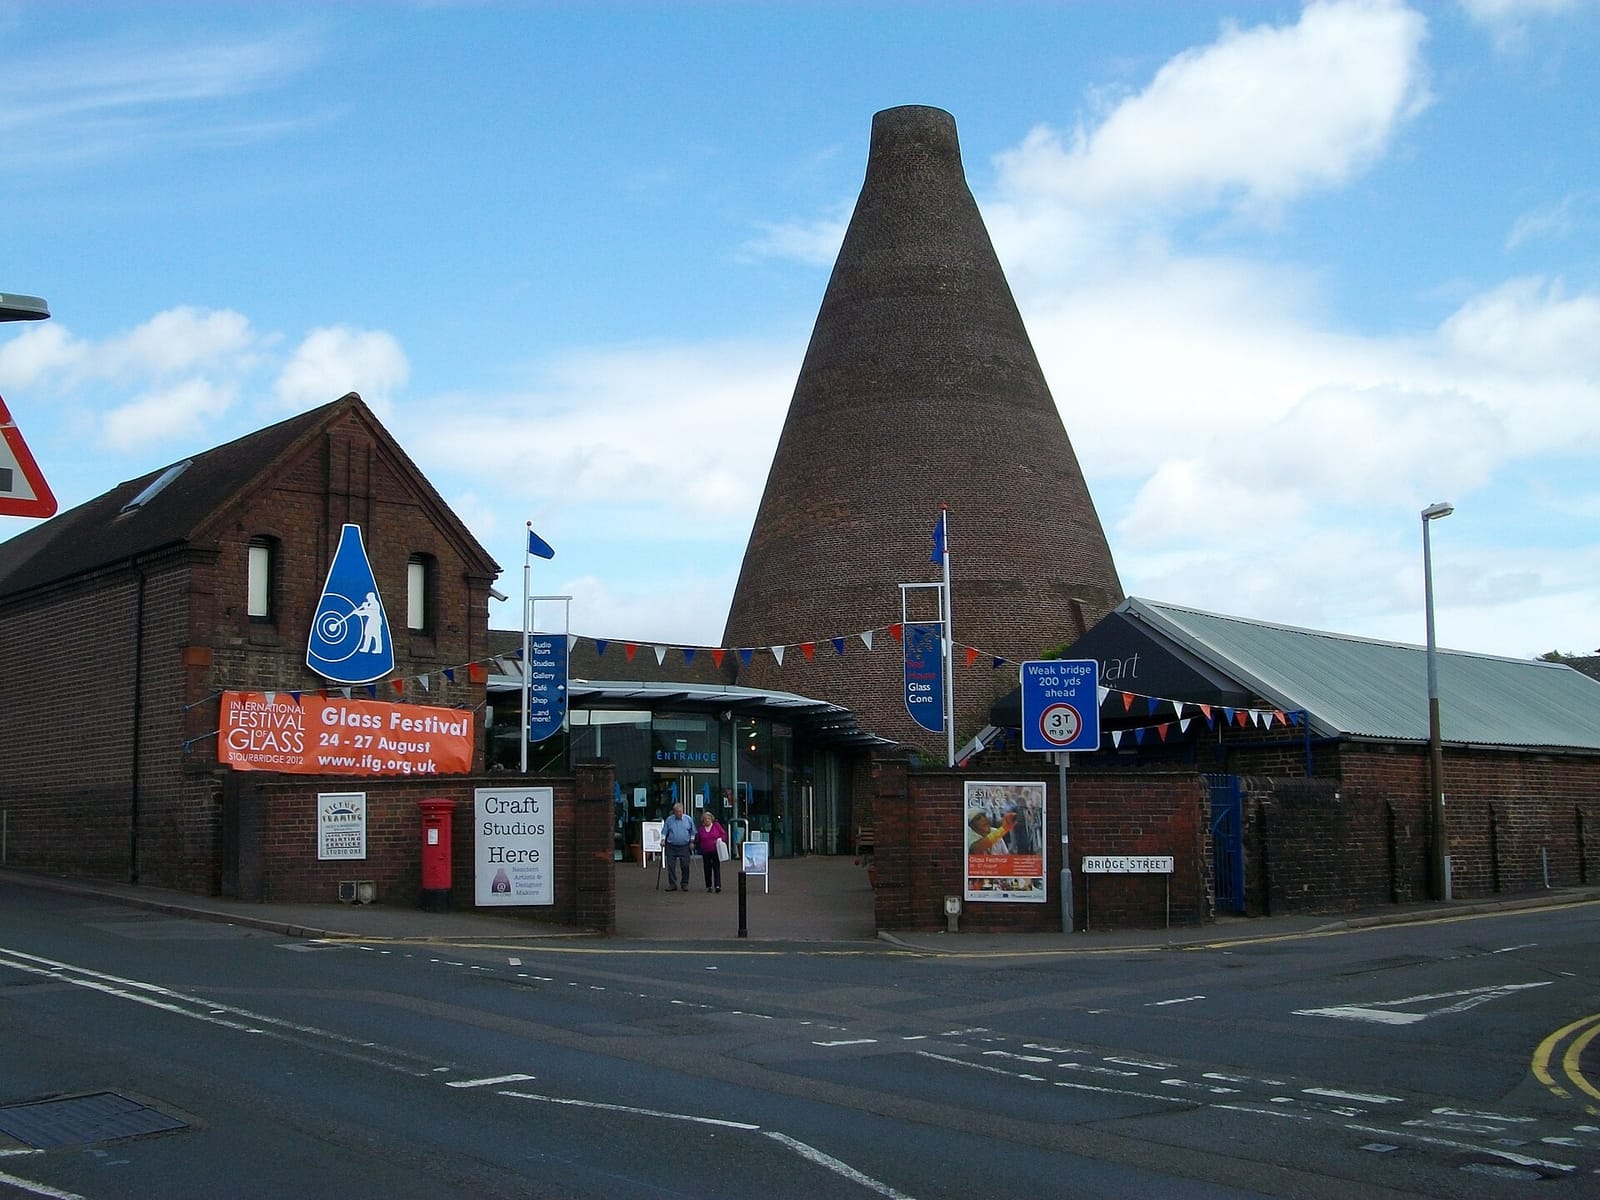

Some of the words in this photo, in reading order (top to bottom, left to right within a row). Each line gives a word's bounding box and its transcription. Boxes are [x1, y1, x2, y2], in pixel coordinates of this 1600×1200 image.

[532, 672, 555, 680] Gallery
[1028, 666, 1056, 675] Weak
[1060, 665, 1091, 676] bridge
[908, 682, 931, 692] Glass
[1039, 677, 1060, 686] 200
[1063, 676, 1081, 688] yds
[532, 684, 547, 692] Café
[1045, 688, 1076, 697] ahead
[532, 697, 548, 705] Shop
[908, 695, 933, 703] Cone
[229, 710, 305, 731] FESTIVAL
[321, 707, 382, 729] Glass
[389, 712, 468, 737] Festival
[255, 730, 268, 738] OF
[228, 728, 304, 753] GLASS
[319, 733, 340, 747] 24
[353, 735, 373, 749] 27
[378, 737, 431, 754] August
[228, 752, 285, 764] STOURBRIDGE
[286, 755, 304, 765] 2012
[656, 751, 717, 762] ENTRANCE
[317, 755, 436, 773] www.ifg.org.uk
[324, 801, 360, 814] PICTURE
[485, 797, 539, 814] Craft
[322, 814, 362, 822] FRAMING
[483, 822, 545, 836] Studios
[488, 846, 540, 863] Here
[1088, 860, 1124, 869] BRIDGE
[1130, 860, 1167, 869] STREET
